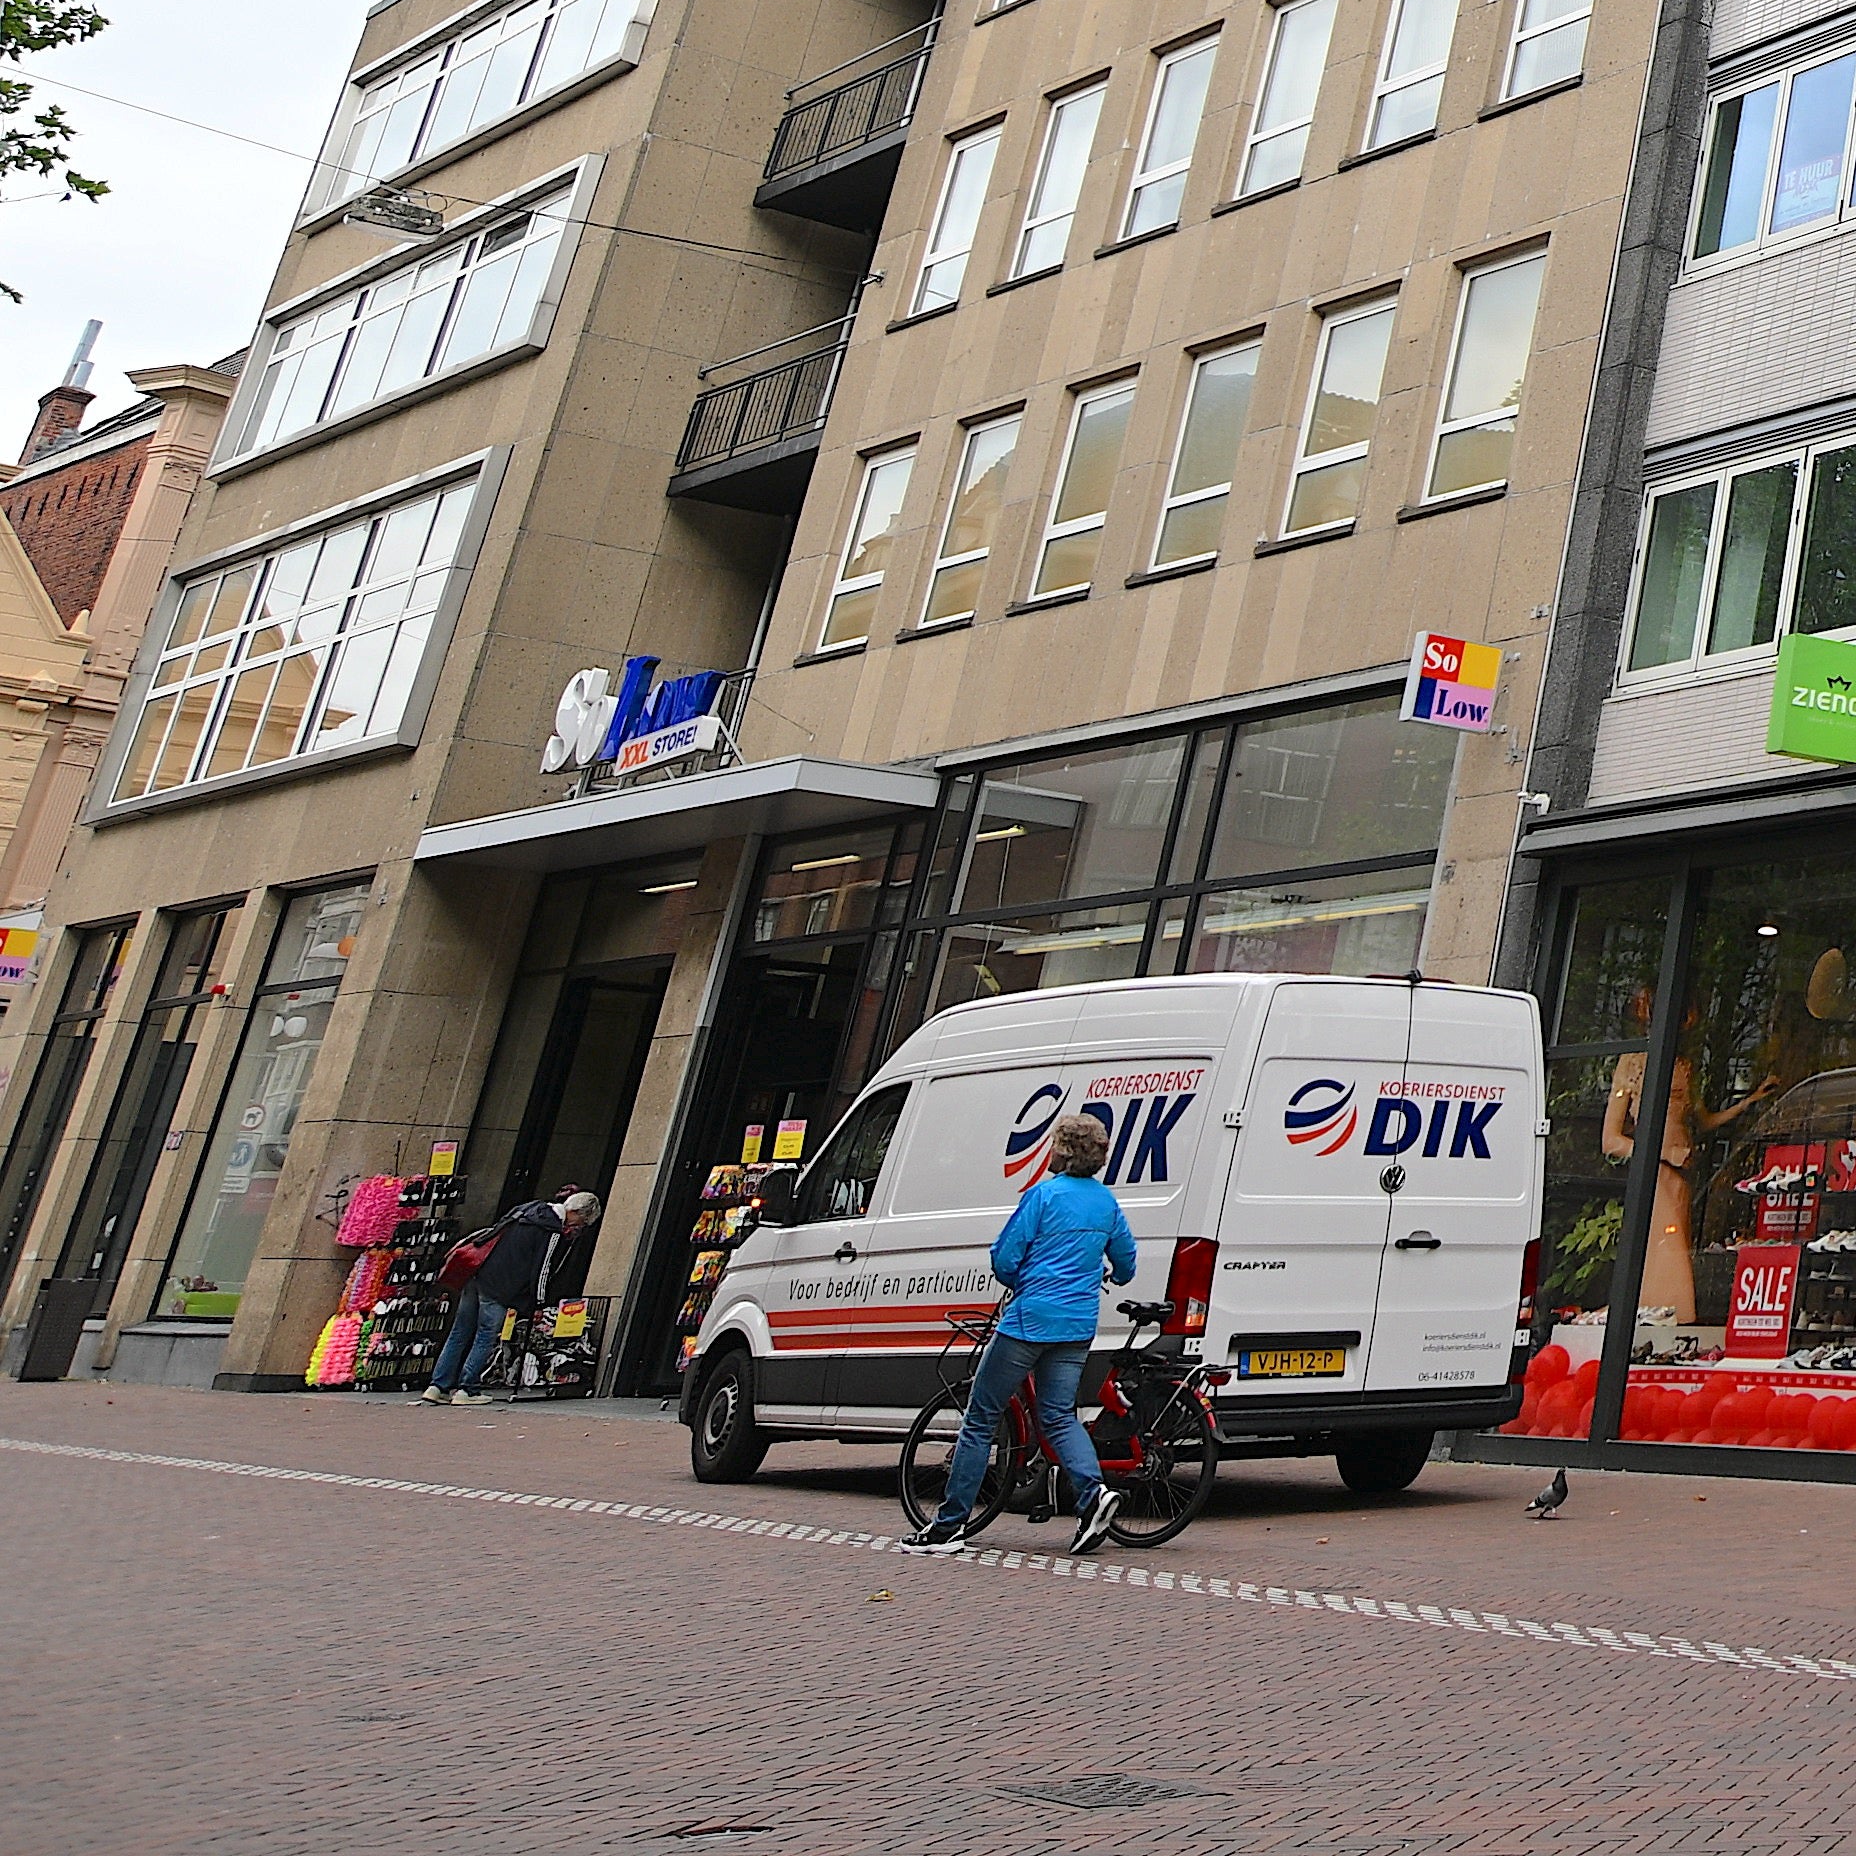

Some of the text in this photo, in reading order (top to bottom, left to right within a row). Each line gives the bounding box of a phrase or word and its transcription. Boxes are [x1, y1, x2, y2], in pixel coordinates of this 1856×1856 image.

[1424, 642, 1458, 673] So
[1435, 689, 1488, 723] Low
[620, 725, 698, 769] XXL STORE!
[1085, 1069, 1205, 1100] KOERIERSDIENST
[1379, 1081, 1505, 1100] KOERIERSDIENST
[1363, 1097, 1503, 1159] DIK
[1223, 1261, 1286, 1271] CRAFTER
[789, 1268, 996, 1304] Voor bedrijf en particulier
[1737, 1266, 1791, 1311] SALE
[1257, 1352, 1334, 1372] VJH-12-P
